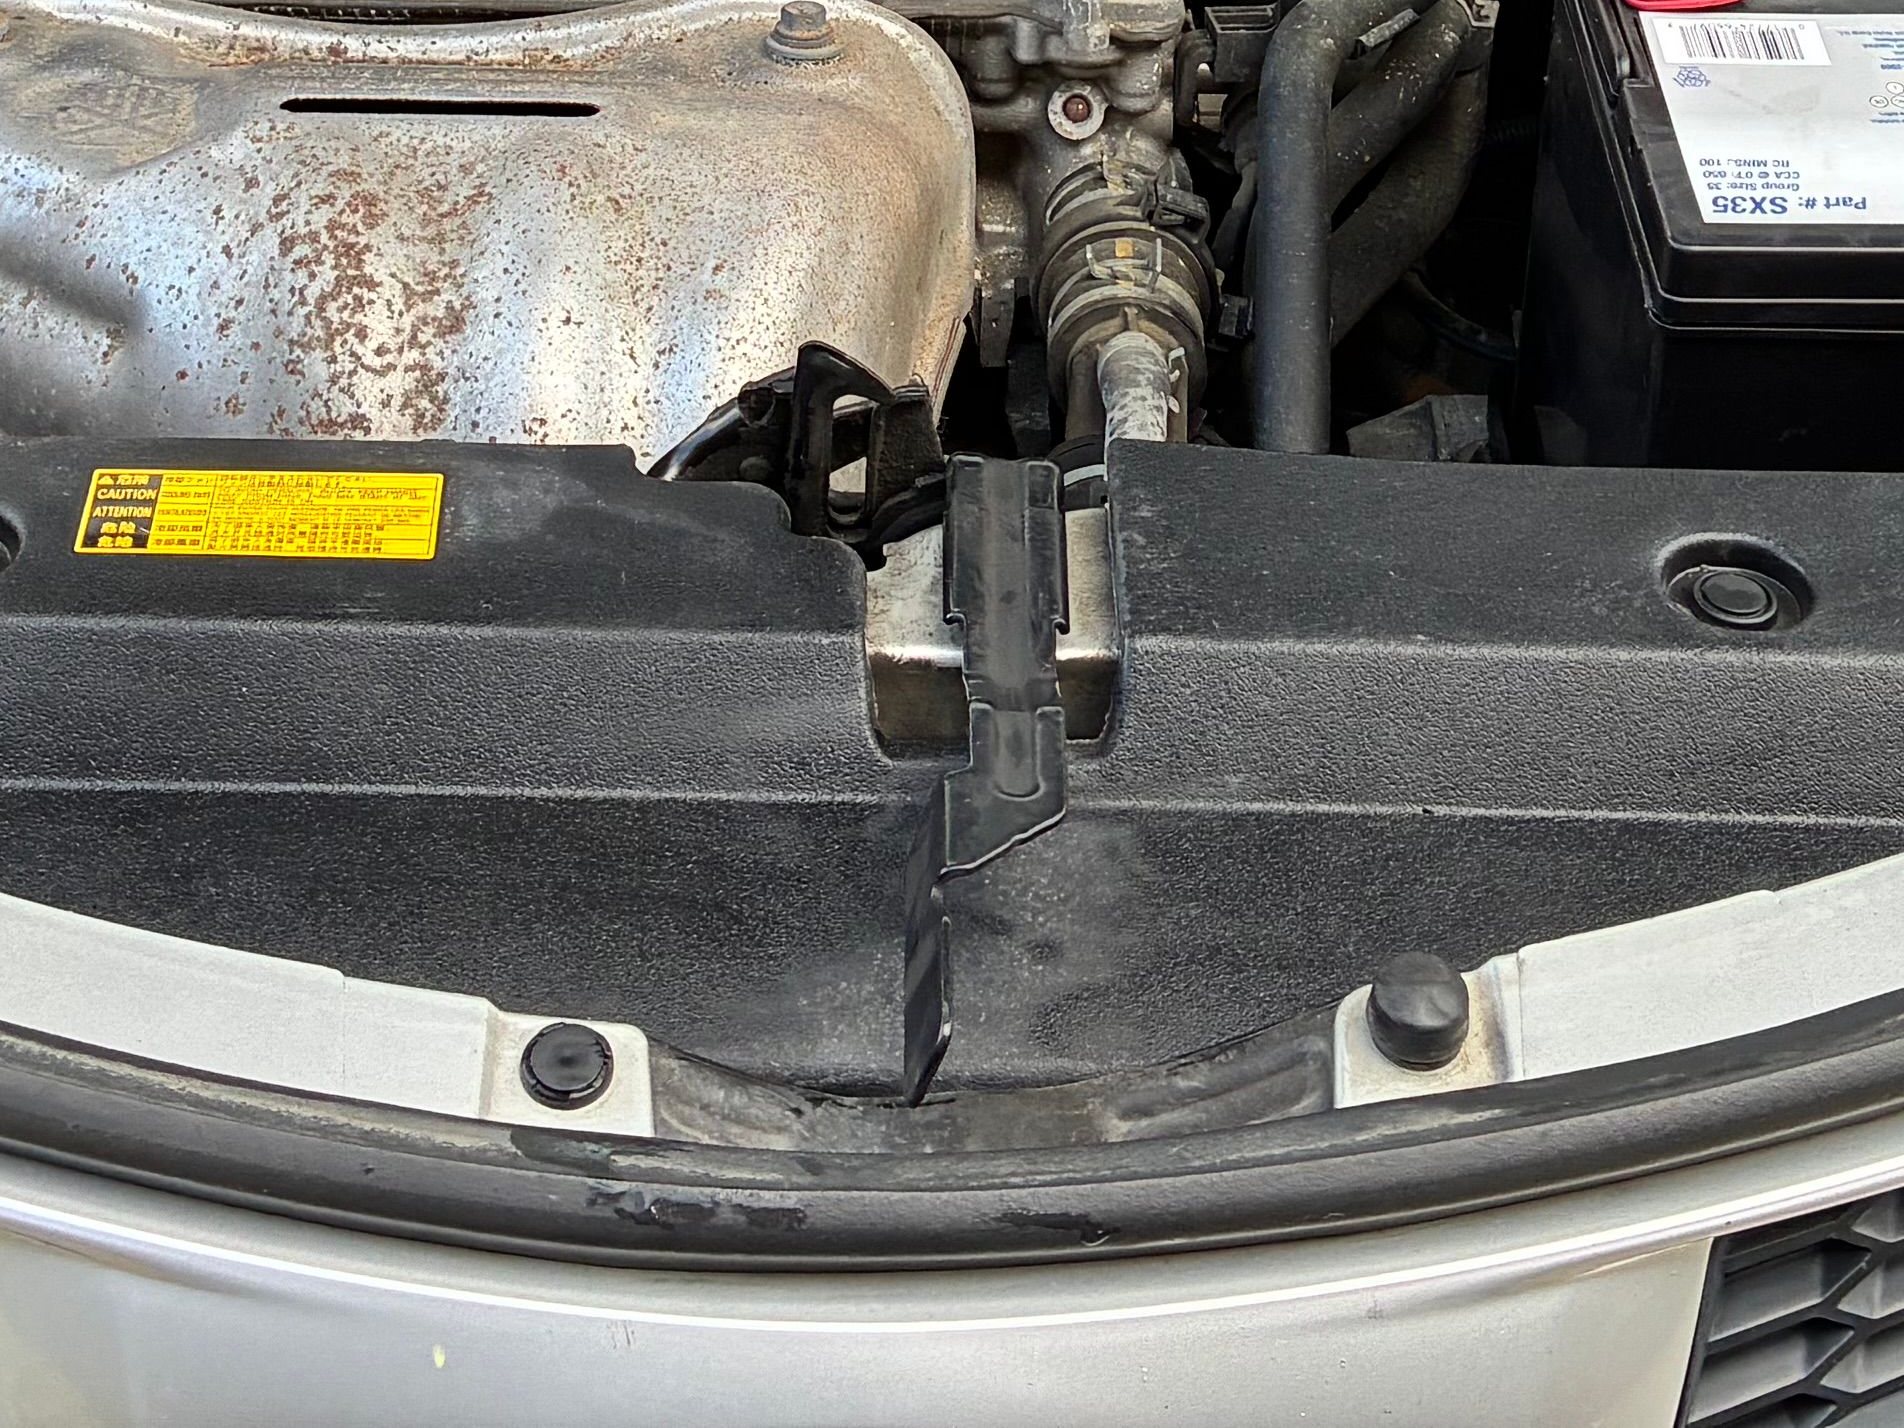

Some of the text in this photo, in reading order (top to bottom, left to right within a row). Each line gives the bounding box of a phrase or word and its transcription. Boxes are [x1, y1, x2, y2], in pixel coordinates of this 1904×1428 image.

[1699, 158, 1722, 166] 100
[1774, 171, 1800, 179] CCA
[1761, 182, 1800, 191] Group
[1712, 196, 1867, 215] Part #: SX35
[97, 488, 158, 500] CAUTION
[93, 506, 152, 518] ATTENTION
